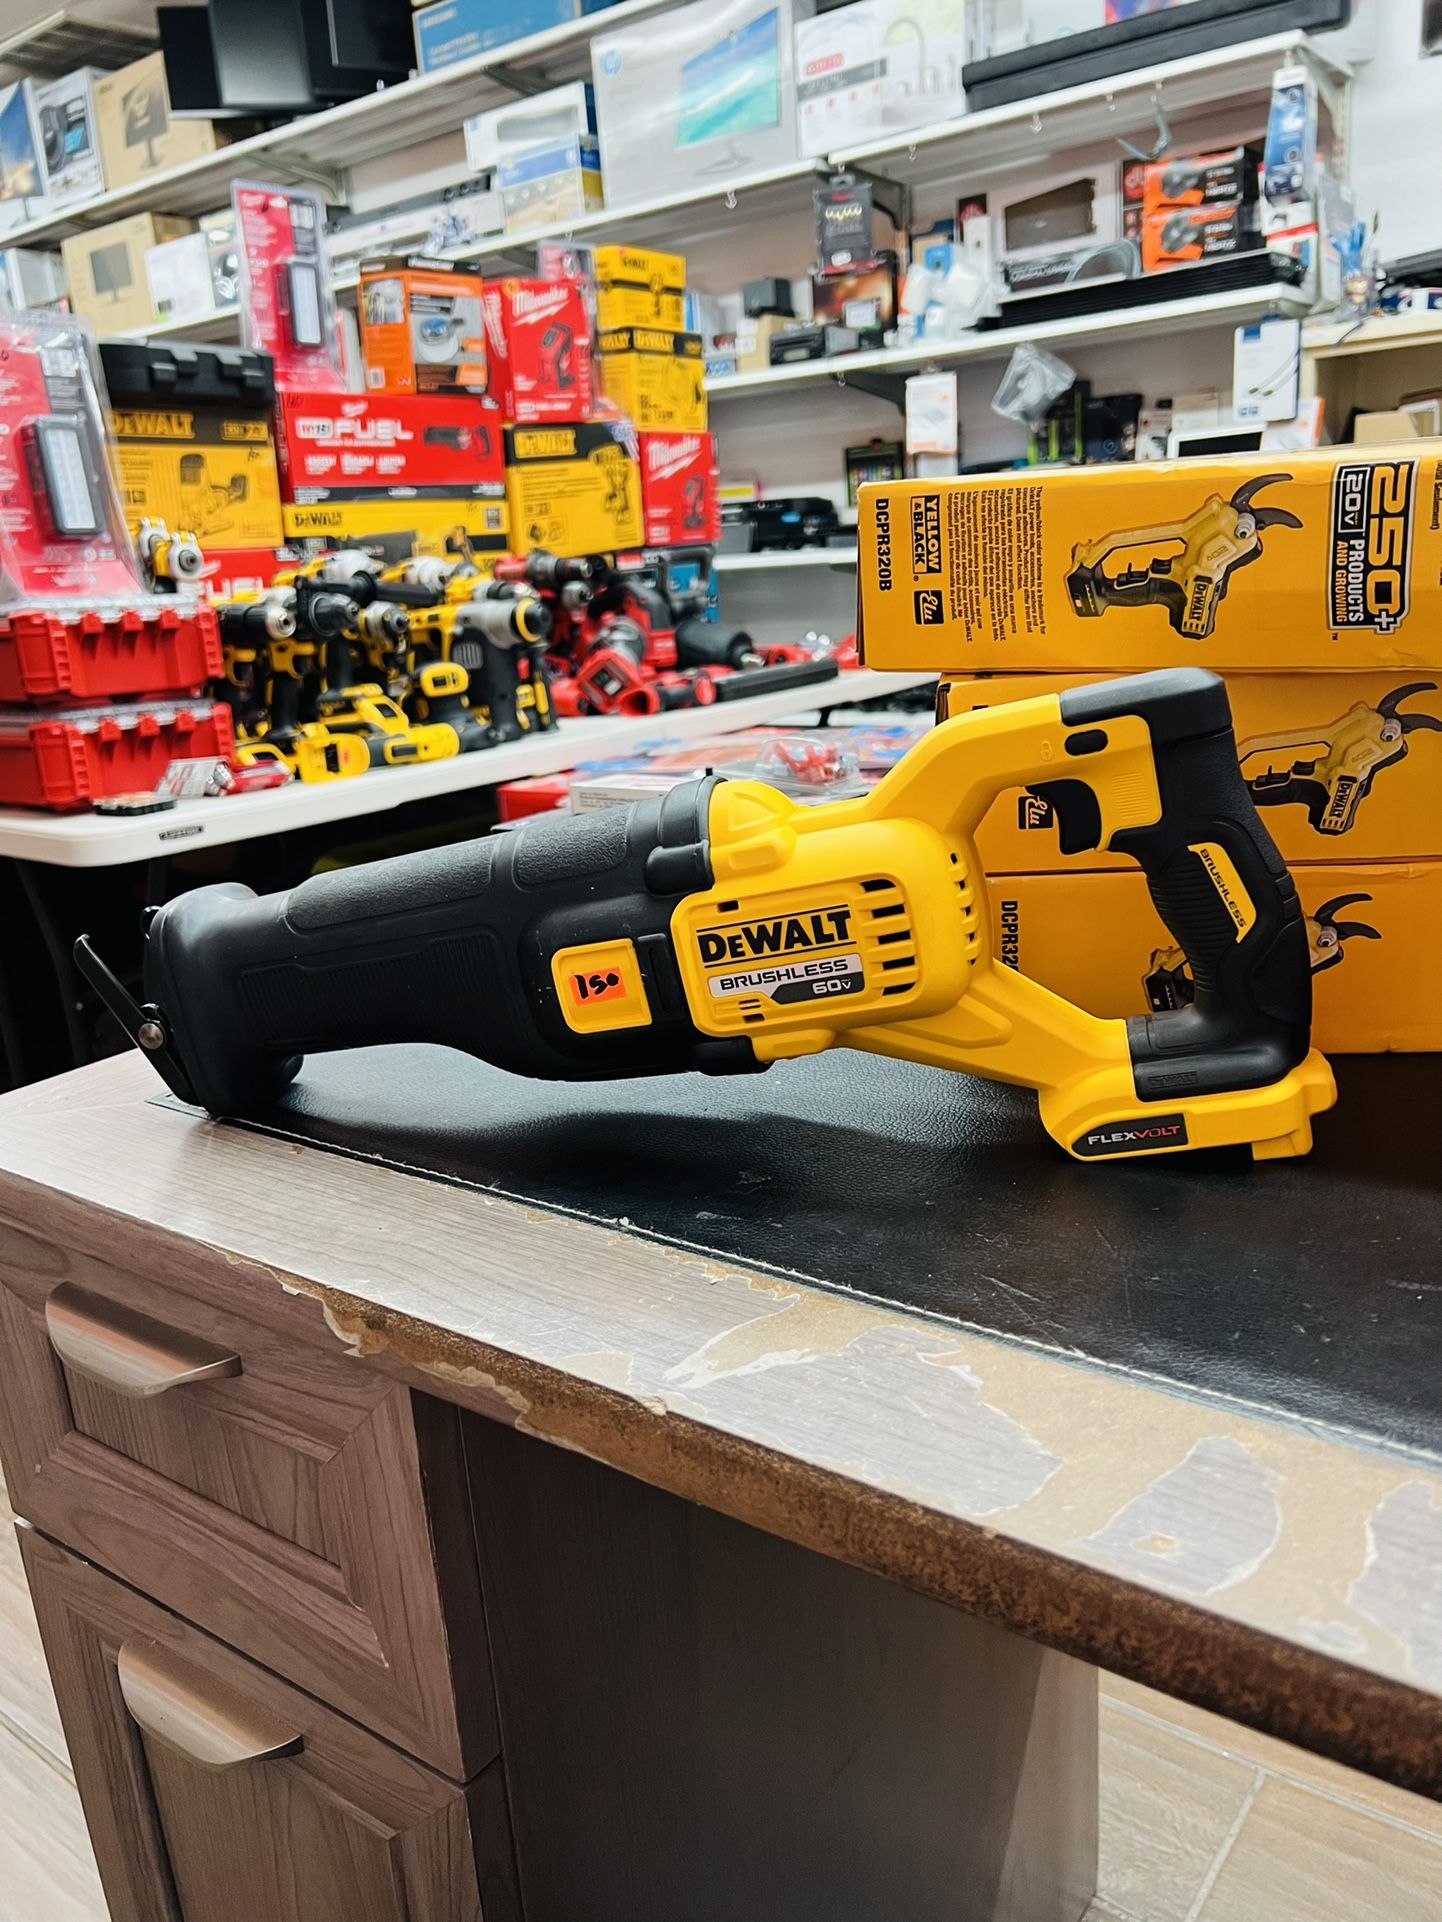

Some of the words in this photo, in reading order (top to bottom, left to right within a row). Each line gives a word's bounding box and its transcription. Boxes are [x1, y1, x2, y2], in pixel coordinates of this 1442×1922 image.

[335, 417, 414, 441] FUEL
[875, 498, 892, 591] DCPR320B
[926, 498, 940, 570] YELLOW
[1336, 541, 1348, 566] AND
[1366, 463, 1409, 629] 250+
[1334, 570, 1348, 622] GROWING
[1347, 539, 1366, 622] PRODUCTS
[1199, 847, 1247, 929] BRUSHLESS
[698, 909, 852, 963] DEWALT
[1001, 901, 1018, 972] DCPR32
[720, 959, 849, 991] BRUSHLESS
[1088, 1125, 1181, 1146] FLEXVOLT
